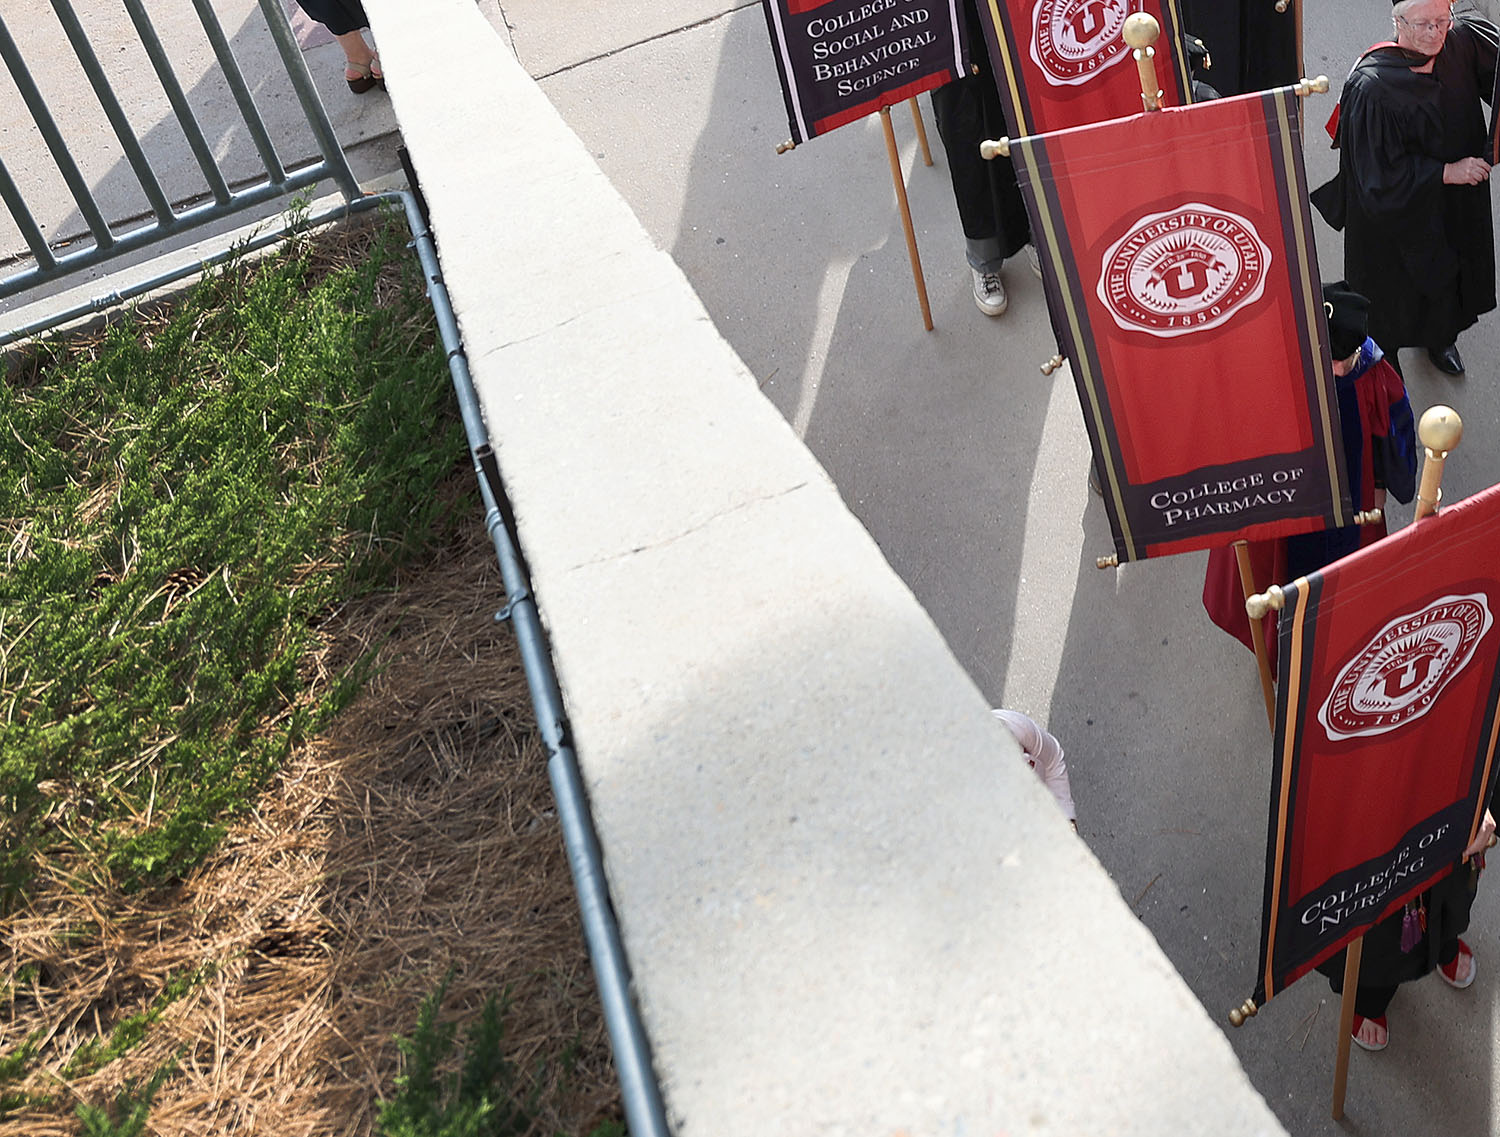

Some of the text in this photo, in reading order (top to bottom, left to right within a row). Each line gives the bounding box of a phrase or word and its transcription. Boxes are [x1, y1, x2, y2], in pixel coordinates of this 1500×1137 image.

[813, 8, 929, 60] SOCIAL AND
[1039, 29, 1050, 61] THE
[812, 30, 937, 82] BEHAVIORAL
[1077, 45, 1117, 73] 1850
[837, 58, 920, 97] SCIENCE
[1111, 214, 1259, 304] THE UNIVERSITY OF UTAH
[1168, 306, 1221, 327] 1850
[1150, 468, 1304, 509] COLLEGE OF
[1163, 489, 1296, 527] PHARMACY
[1333, 604, 1479, 717] THE UNIVERSITY OF UTAH
[1374, 695, 1432, 726] 1850
[1418, 824, 1449, 849] OF
